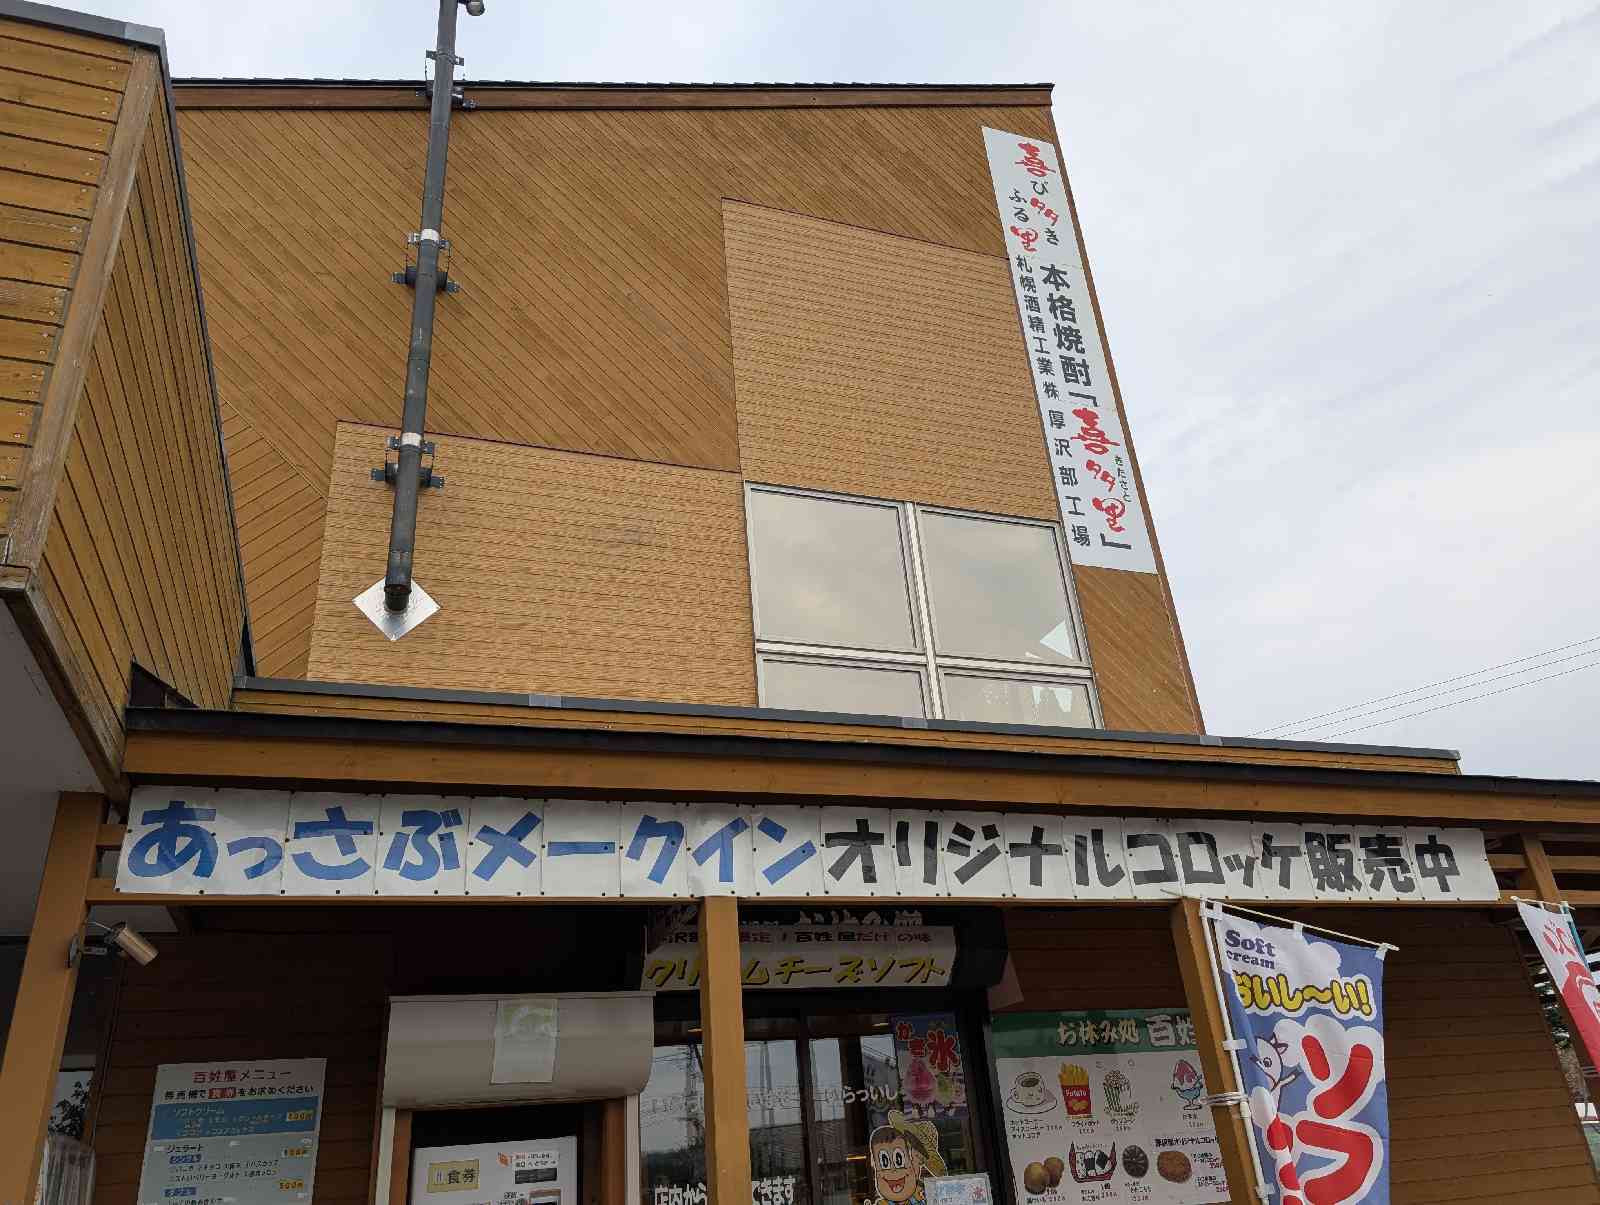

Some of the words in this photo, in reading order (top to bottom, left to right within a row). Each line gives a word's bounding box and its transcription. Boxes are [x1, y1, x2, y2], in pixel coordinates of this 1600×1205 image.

[1225, 929, 1276, 957] Soft
[1057, 1019, 1139, 1046] お休み処
